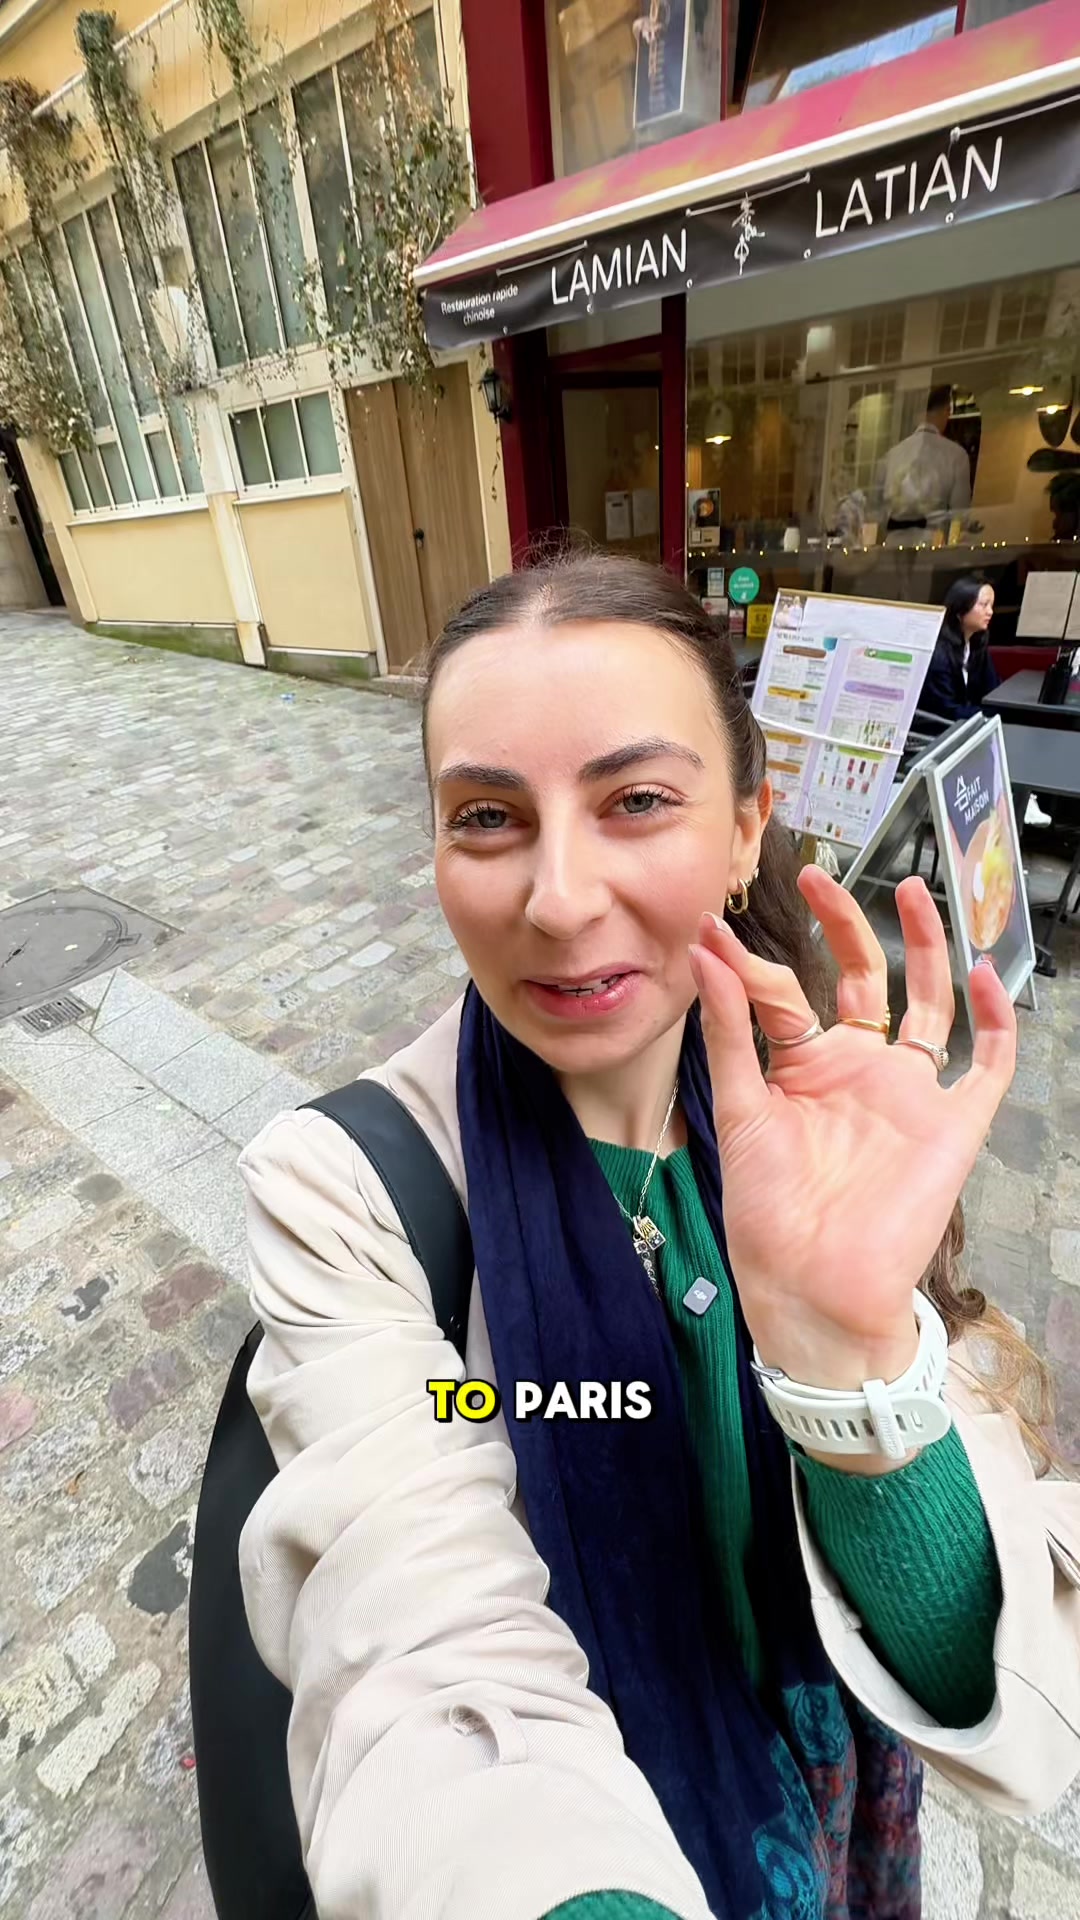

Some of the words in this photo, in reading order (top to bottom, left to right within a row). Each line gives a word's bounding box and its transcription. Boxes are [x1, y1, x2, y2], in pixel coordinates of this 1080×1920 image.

[551, 228, 687, 305] LAMIAN
[815, 136, 1003, 239] LATIAN
[441, 292, 491, 316] Restauration
[492, 283, 519, 303] rapide
[463, 307, 495, 327] chinoise
[966, 776, 981, 801] FAIT
[964, 789, 989, 825] MAISON
